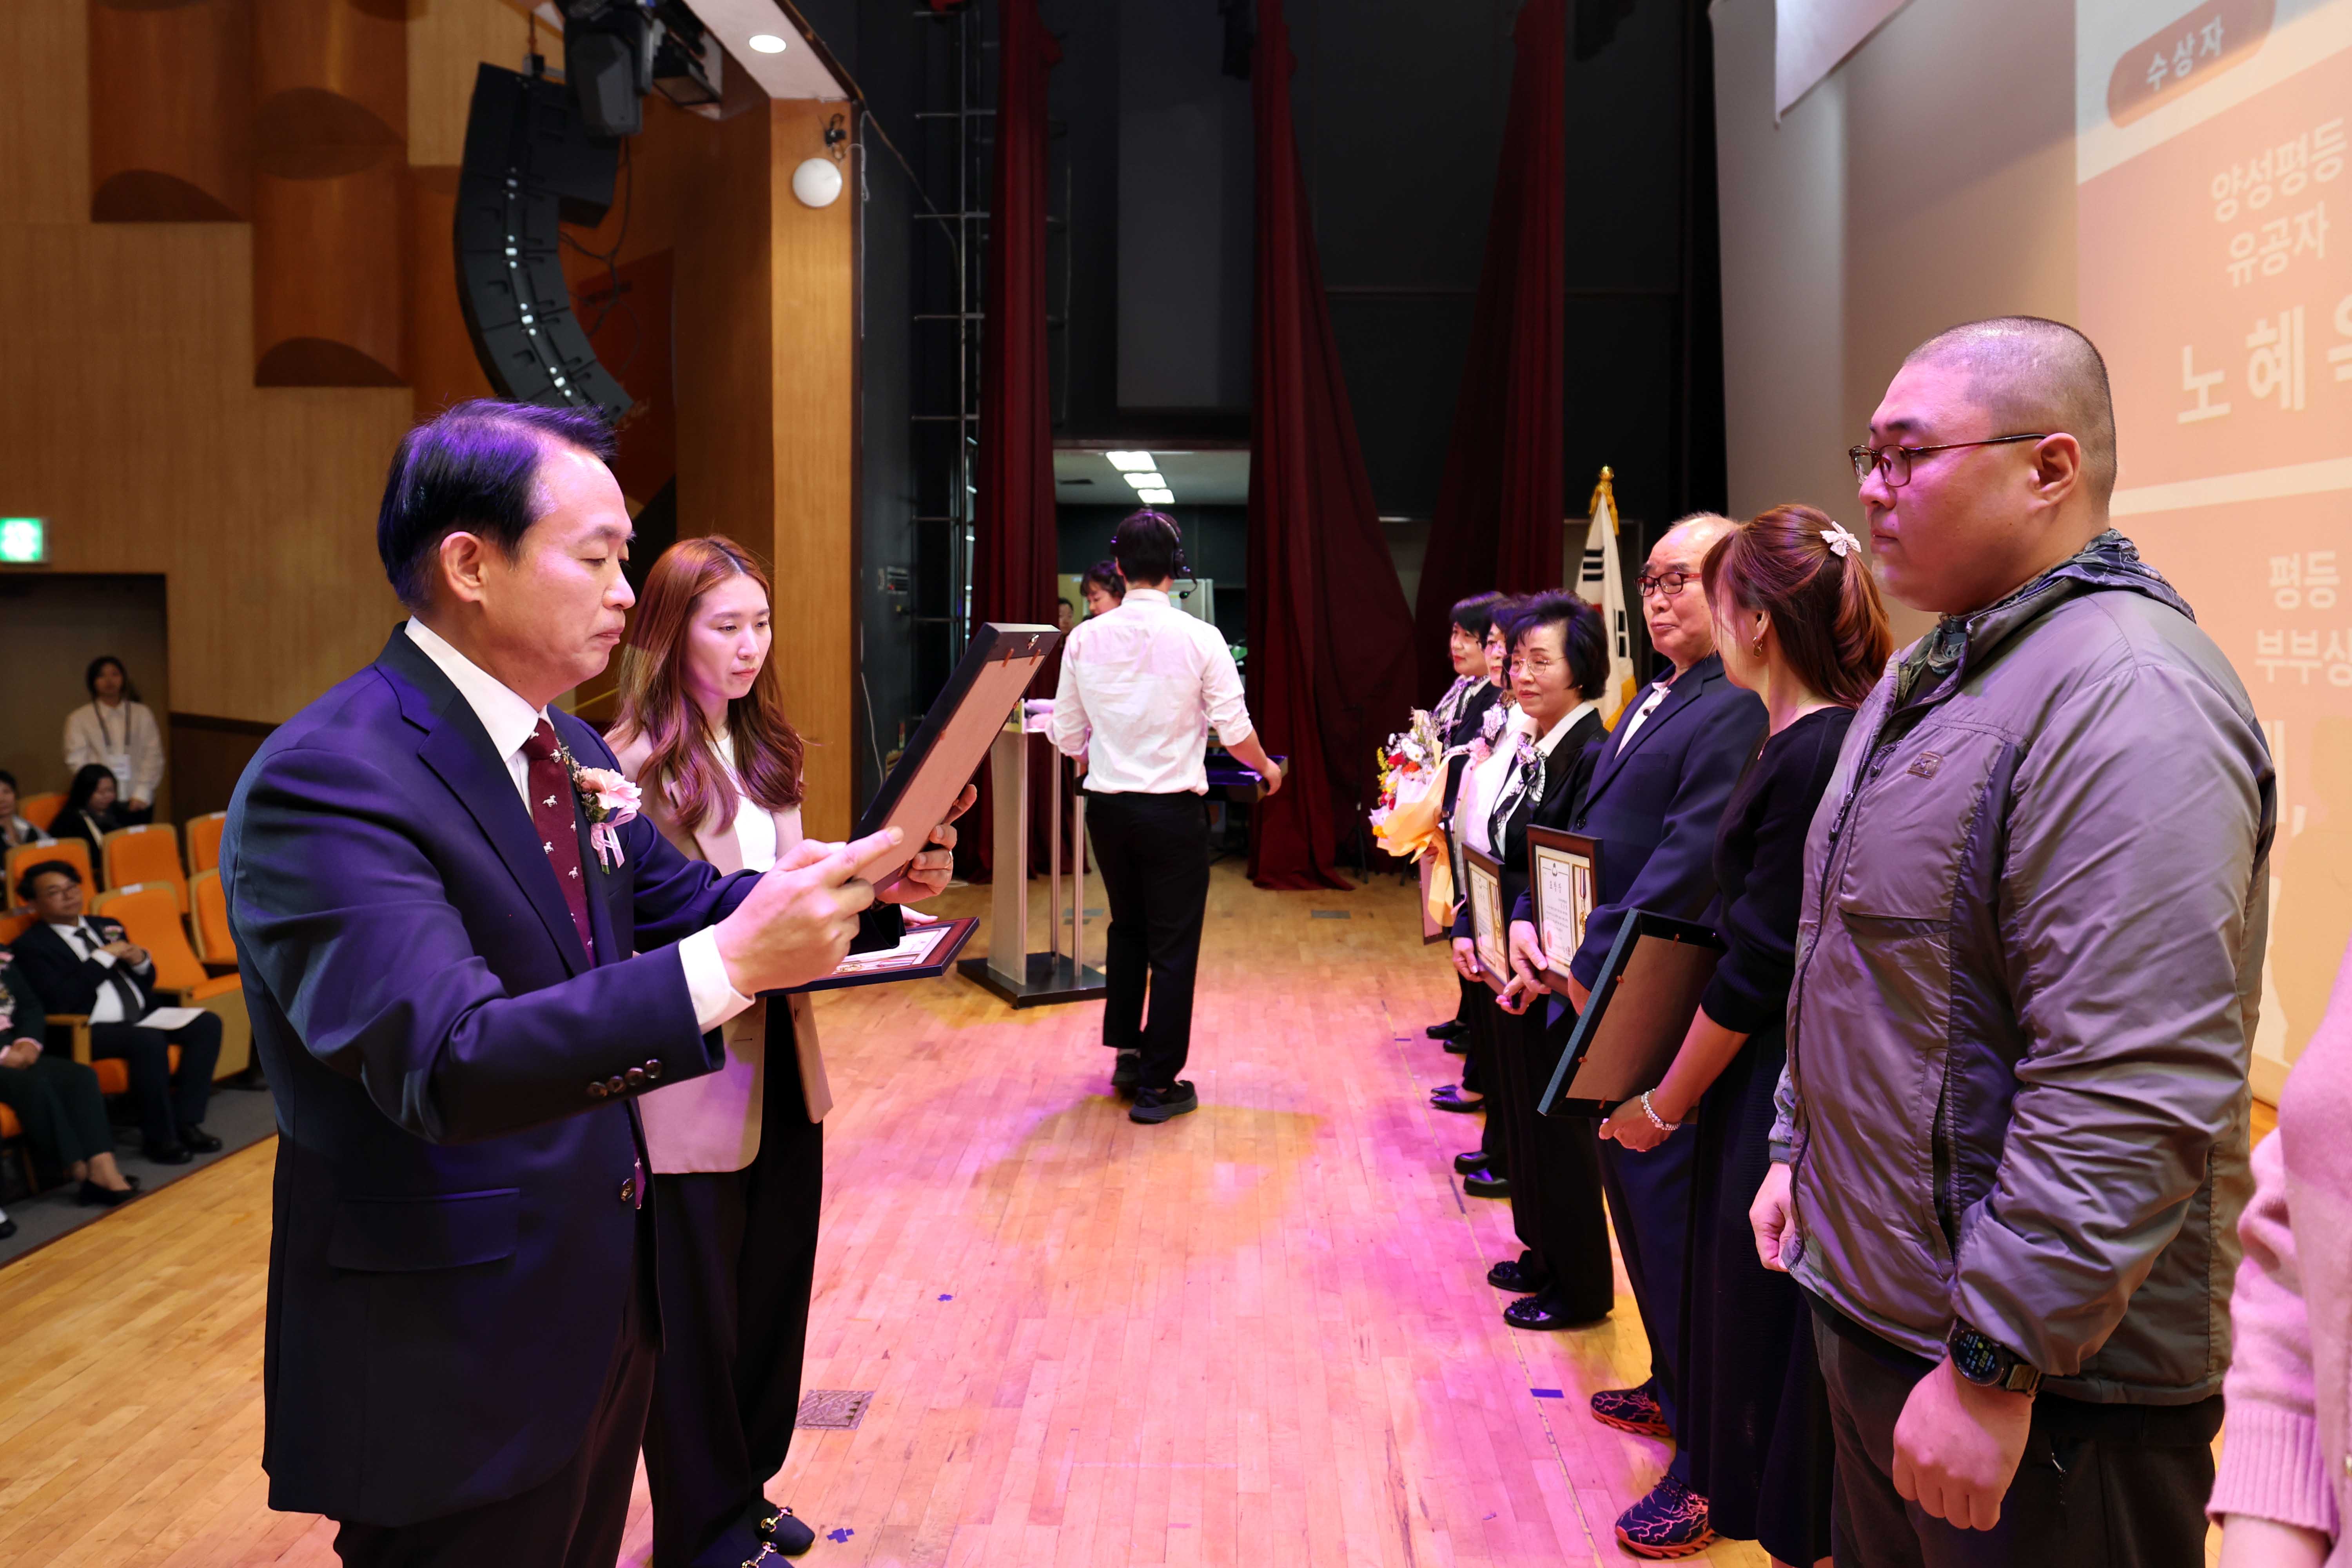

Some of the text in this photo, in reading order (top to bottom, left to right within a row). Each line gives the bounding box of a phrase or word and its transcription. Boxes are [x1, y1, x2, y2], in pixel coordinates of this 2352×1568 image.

[2147, 15, 2224, 91] 수상자
[2211, 118, 2348, 223] 양성평등
[2227, 200, 2330, 288] 유공자
[2269, 550, 2339, 610] 평등
